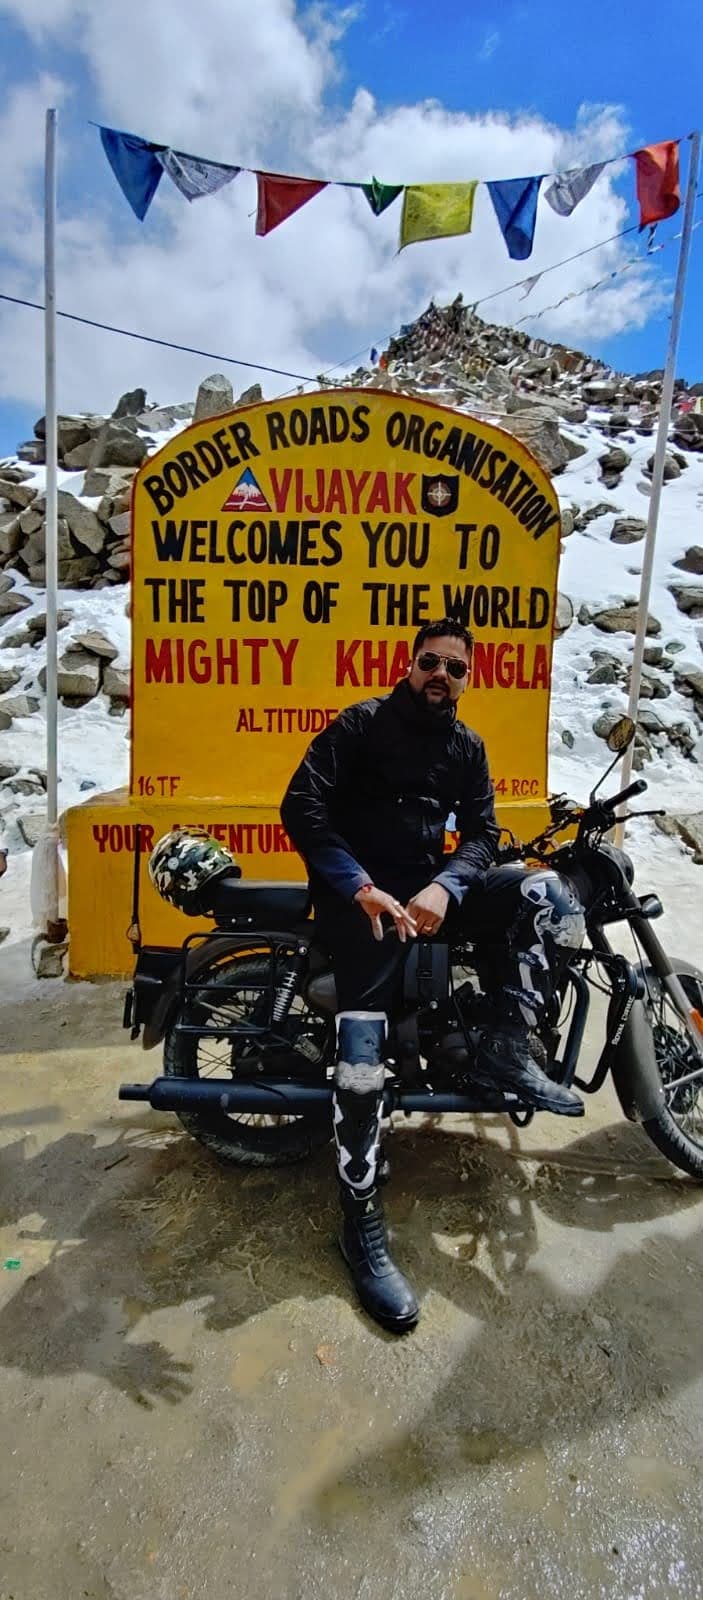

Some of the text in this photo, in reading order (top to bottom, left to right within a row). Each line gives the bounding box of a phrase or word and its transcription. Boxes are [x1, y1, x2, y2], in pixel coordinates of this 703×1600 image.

[143, 405, 560, 540] BORDER ROADS ORGANISATION
[269, 468, 417, 515] VIJAYAK
[152, 520, 500, 570] WELCOMES YOU TO
[144, 578, 550, 630] THE TOP OF THE WORLD
[144, 638, 550, 690] MIGHTY KHANGLA
[236, 708, 339, 733] ALTITUDE
[138, 776, 180, 796] 16 TF
[491, 778, 539, 796] 4 RCC
[92, 824, 155, 853] YOUR
